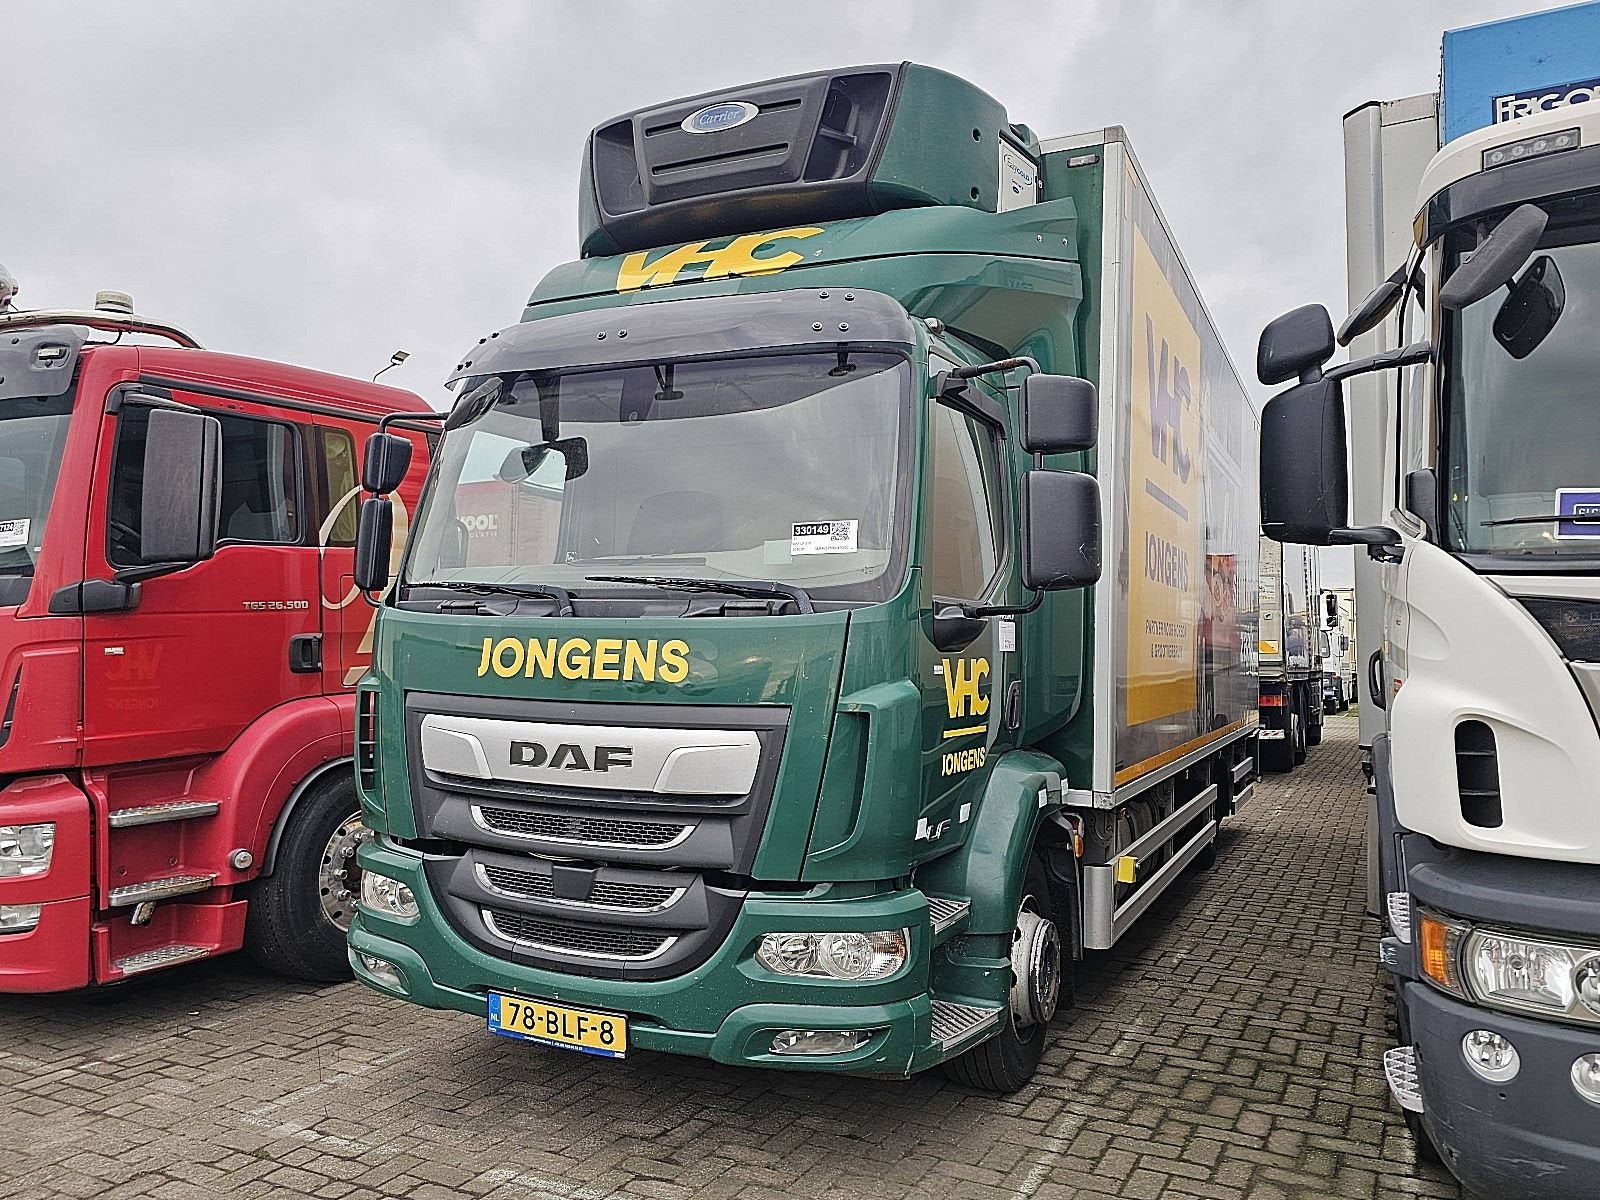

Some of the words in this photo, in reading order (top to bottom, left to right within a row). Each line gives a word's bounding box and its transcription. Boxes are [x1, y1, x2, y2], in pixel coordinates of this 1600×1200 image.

[699, 110, 740, 125] Carrier
[1496, 85, 1600, 124] FRIGO
[616, 227, 826, 295] VHC
[1145, 312, 1191, 484] VHC
[794, 524, 830, 536] 330149
[1144, 531, 1189, 592] JONGENS
[242, 601, 266, 611] TGS
[268, 600, 309, 610] 26.500
[477, 637, 690, 684] JONGENS
[942, 657, 990, 719] VHC
[509, 740, 633, 773] DAF
[941, 746, 986, 777] JONGENS
[490, 1012, 500, 1023] NL
[508, 1002, 615, 1046] 78-BLF-8
